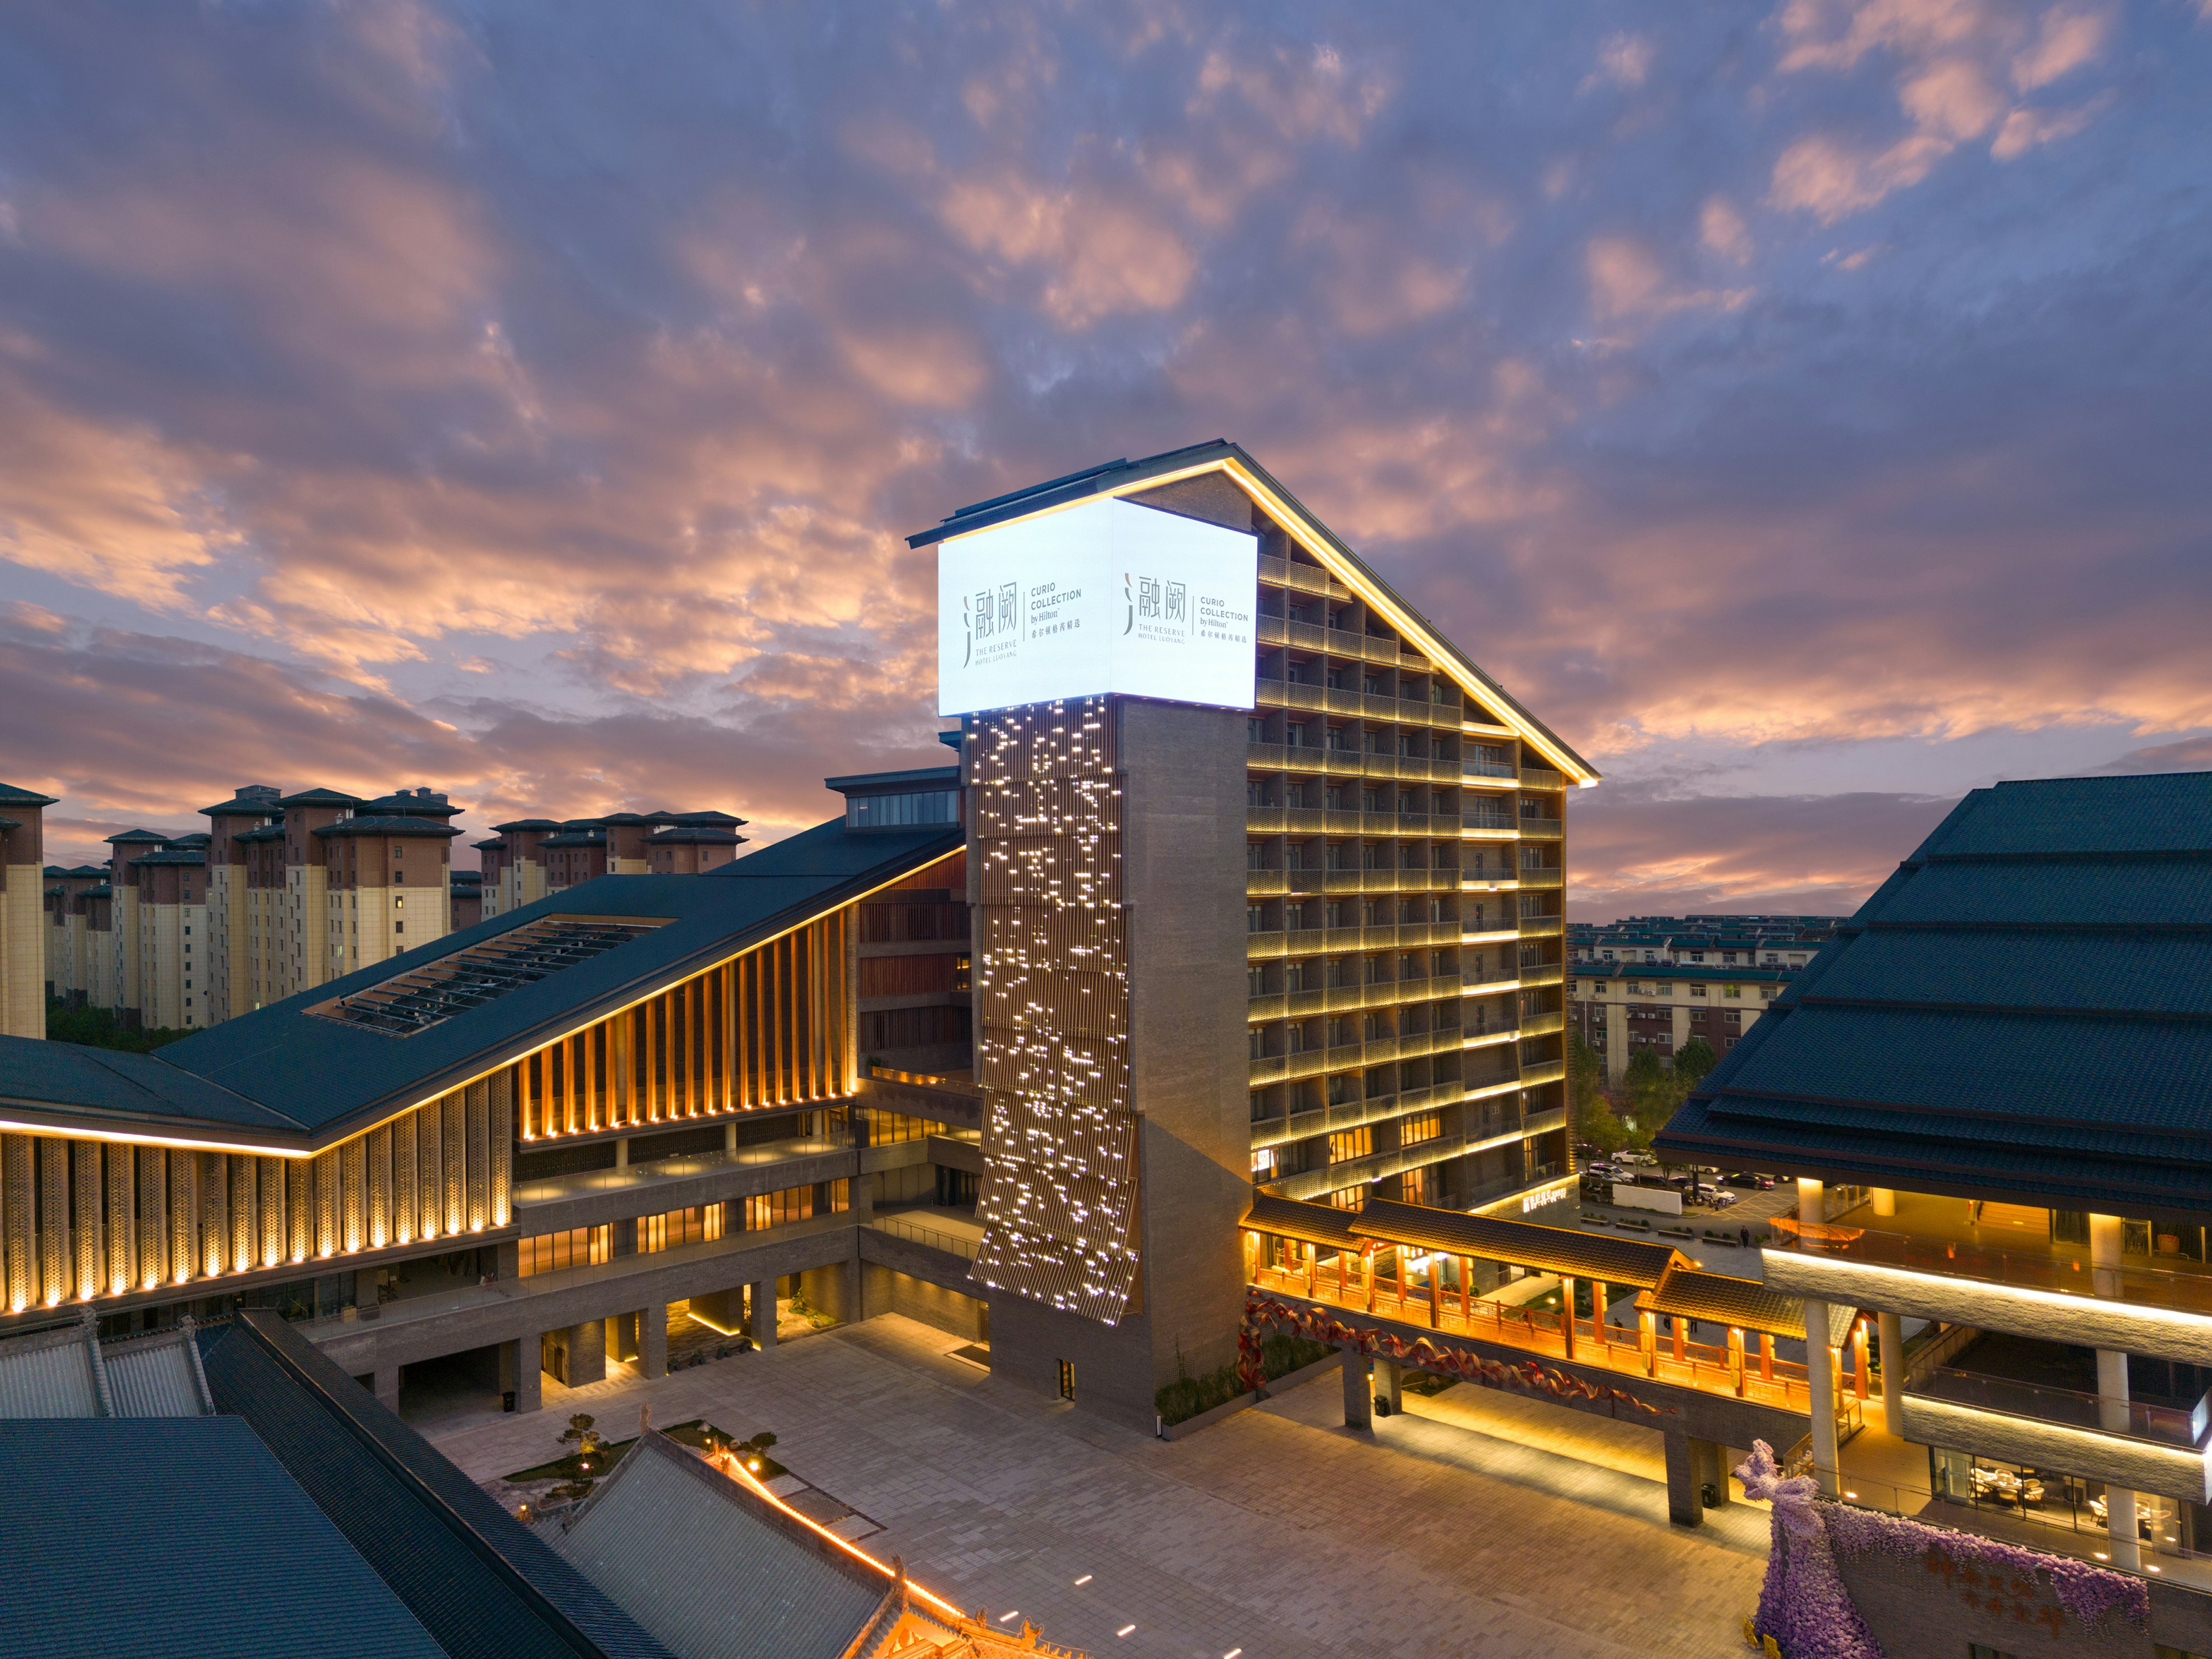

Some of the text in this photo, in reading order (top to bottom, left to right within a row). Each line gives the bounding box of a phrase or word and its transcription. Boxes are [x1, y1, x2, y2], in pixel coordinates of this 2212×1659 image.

[1031, 582, 1055, 597] CURIO
[1031, 589, 1081, 610] COLLECTION
[1201, 597, 1224, 607] CURIO
[1031, 615, 1038, 625] by
[1201, 608, 1248, 621] COLLECTION
[1201, 617, 1207, 626] by
[1032, 618, 1080, 639] 希尔顿格芮精选
[1139, 624, 1185, 637] THE RESERVE
[1201, 630, 1246, 643] 希尔顿格芮精选
[976, 639, 1016, 656] THE RESERVE
[976, 650, 1016, 666] HOTEL LUOYANG
